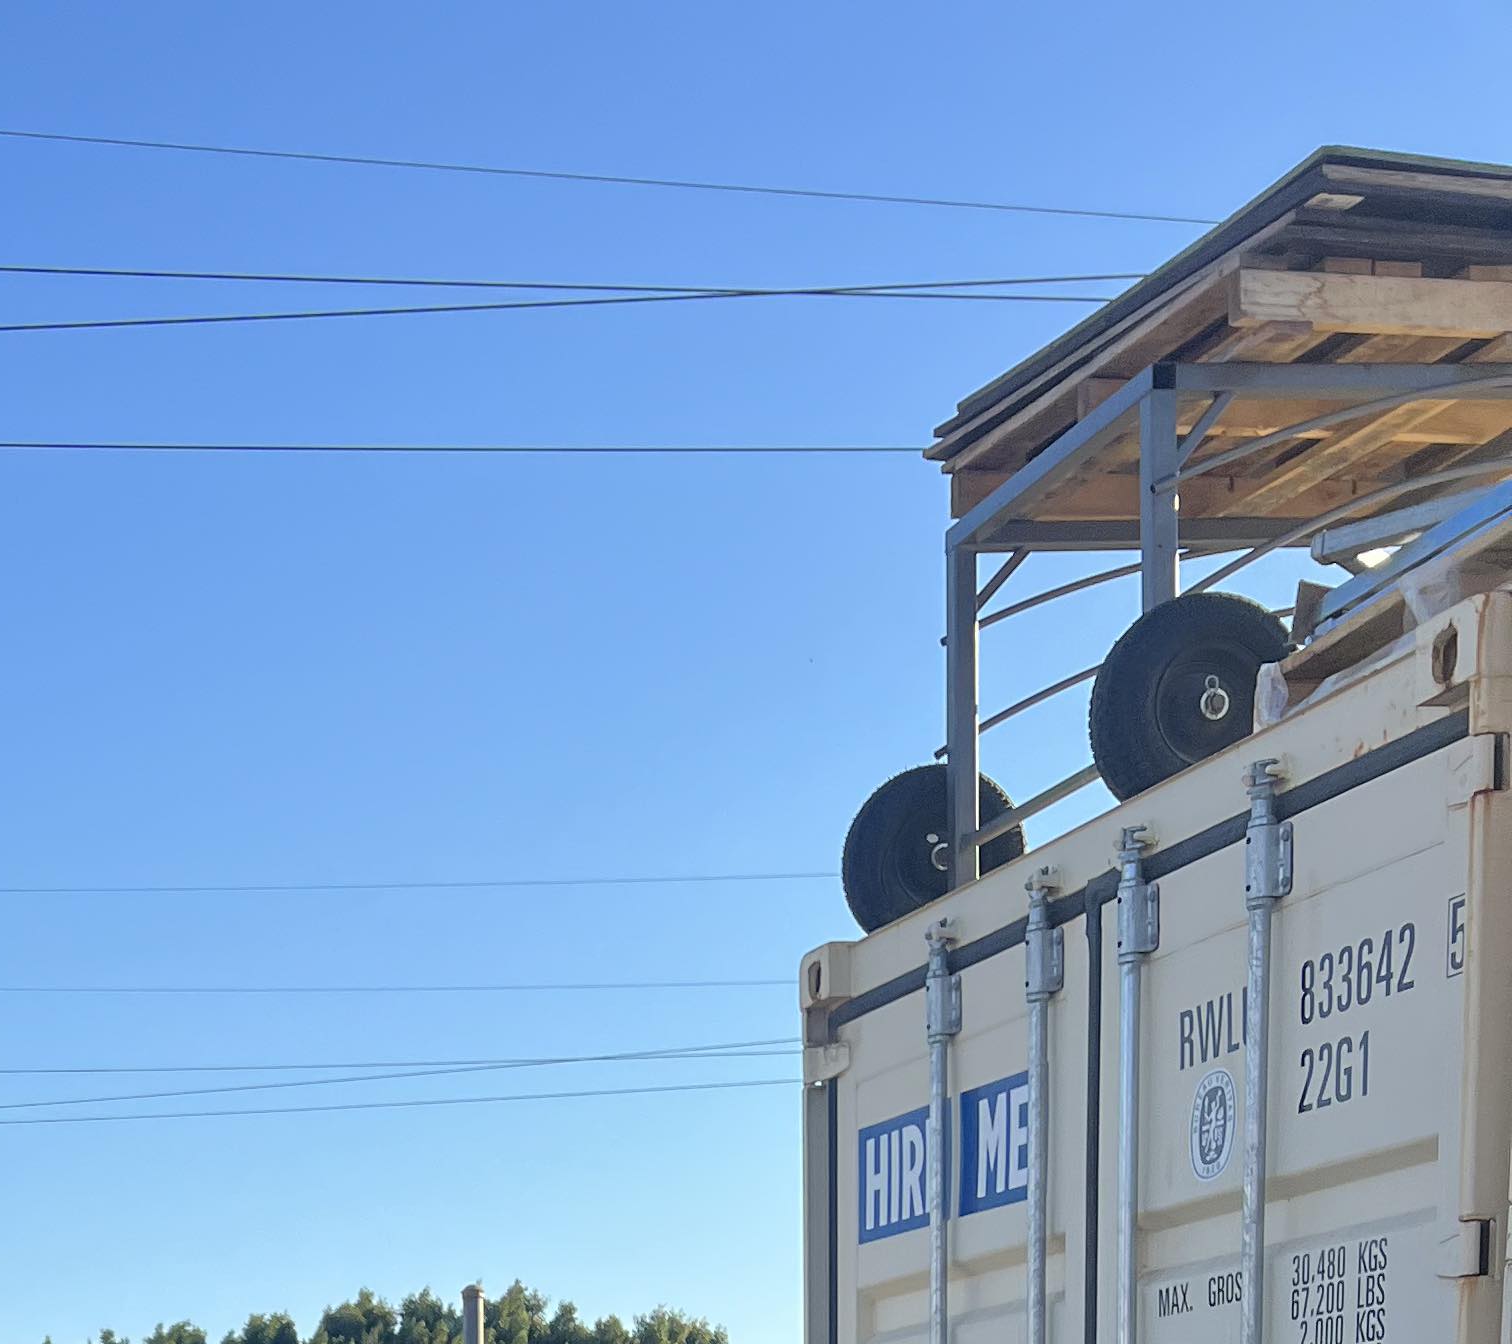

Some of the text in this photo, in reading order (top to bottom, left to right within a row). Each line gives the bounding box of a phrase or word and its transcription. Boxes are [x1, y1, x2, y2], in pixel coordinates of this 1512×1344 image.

[1300, 922, 1415, 1025] 833642
[1298, 1030, 1369, 1114] 22G1
[977, 1084, 1029, 1199] ME
[1158, 1282, 1193, 1318] MAX.
[1292, 1246, 1346, 1287] 30,480
[1358, 1237, 1388, 1275] KGS
[1291, 1272, 1386, 1321] 67,200 LBS
[1355, 1307, 1386, 1344] KGS
